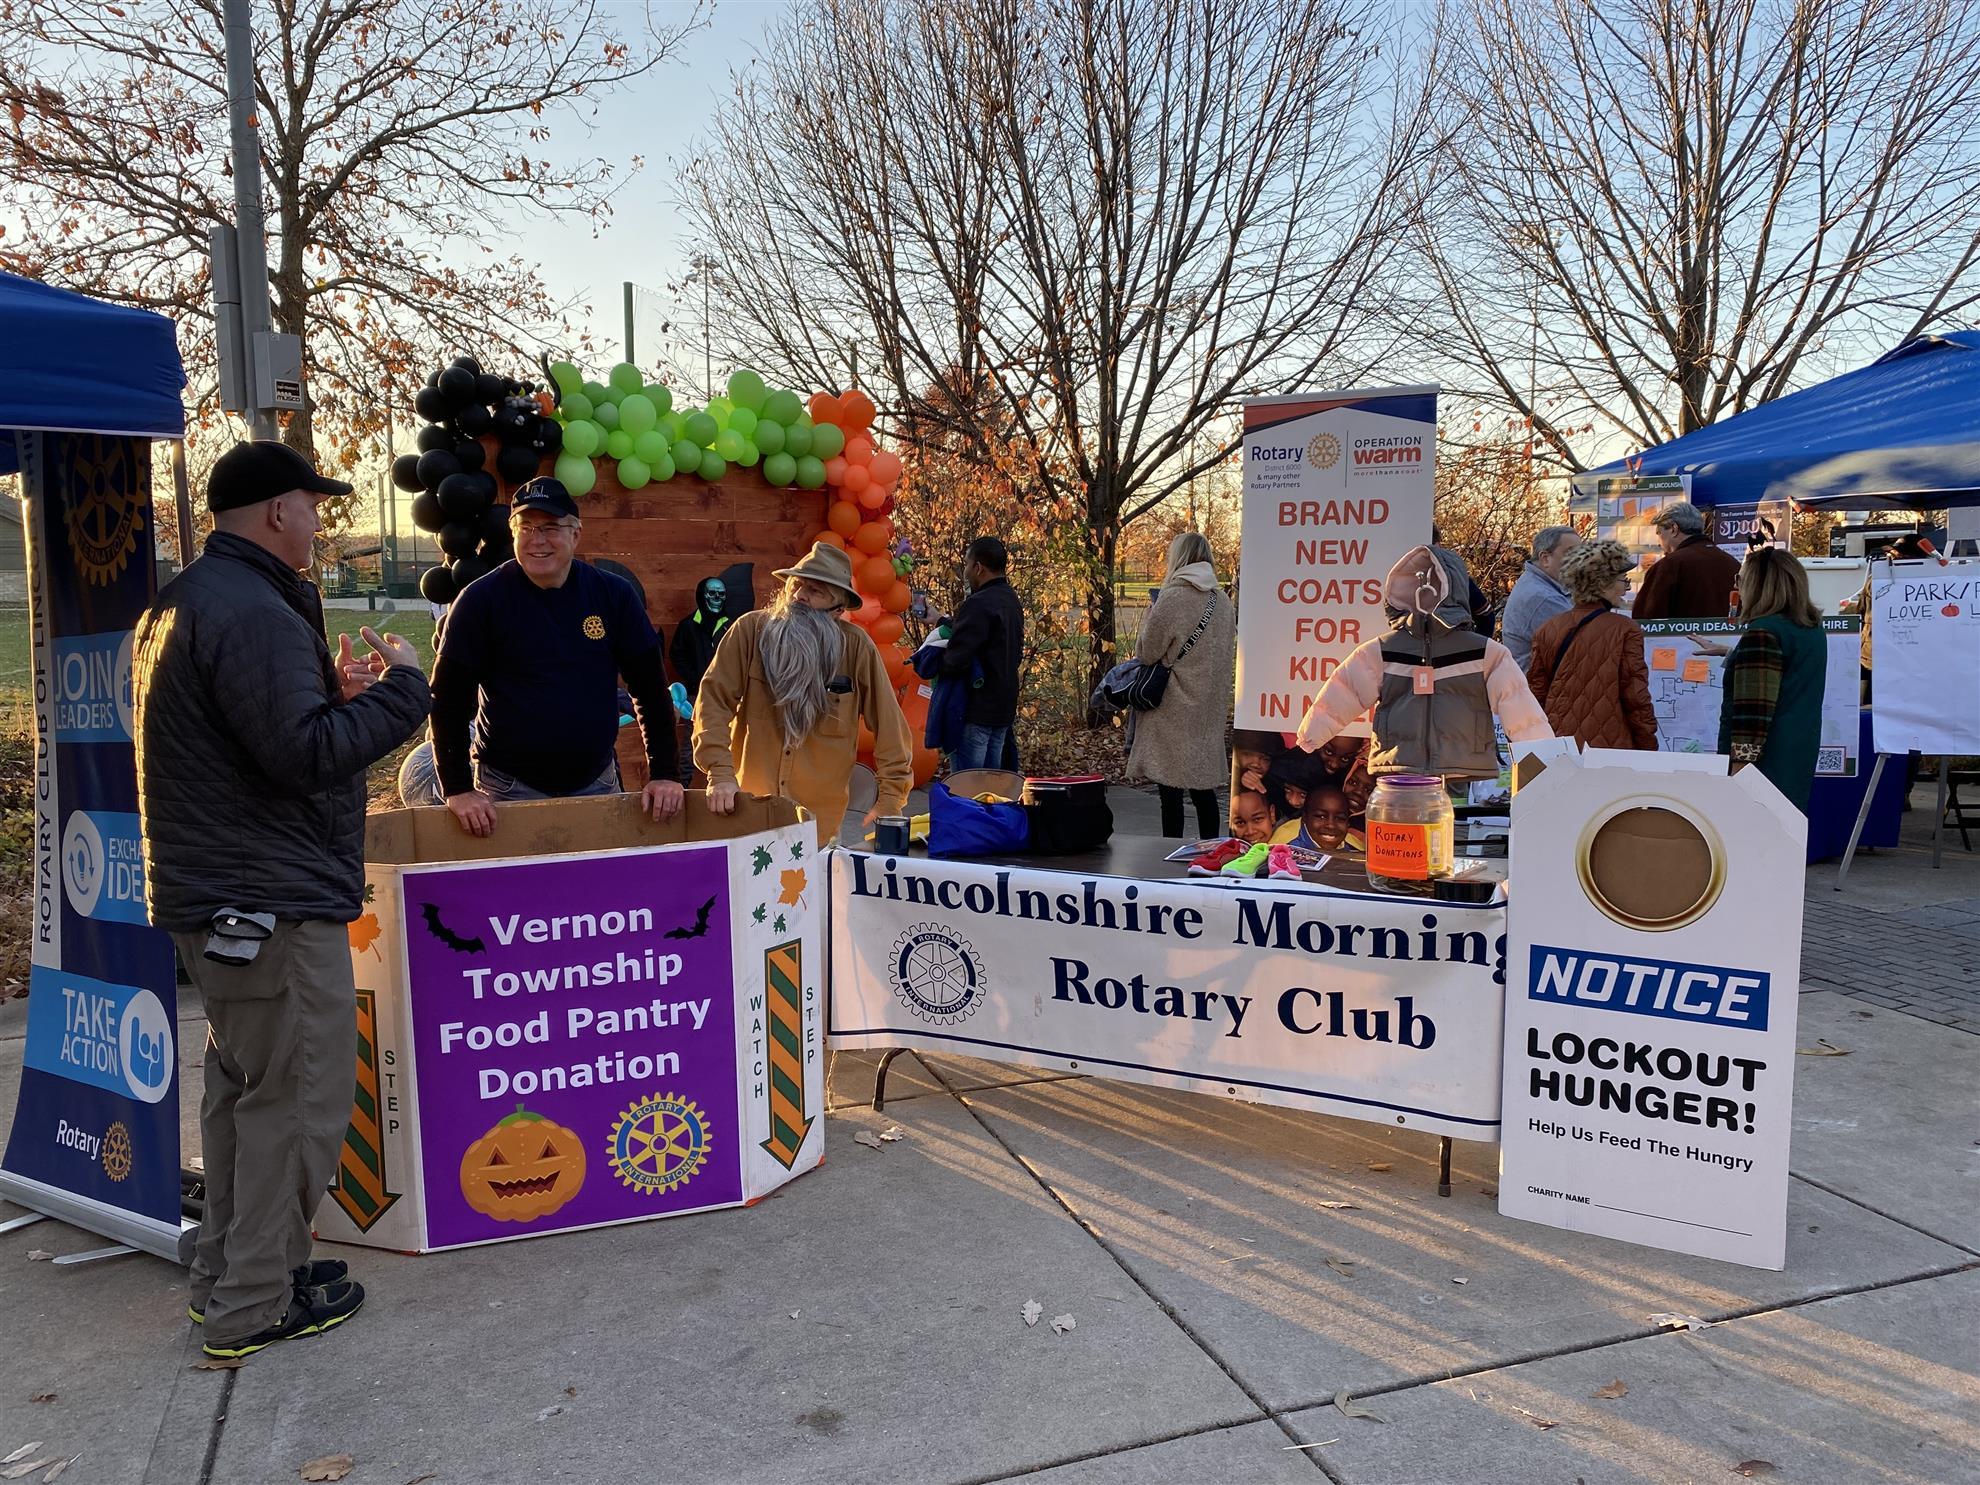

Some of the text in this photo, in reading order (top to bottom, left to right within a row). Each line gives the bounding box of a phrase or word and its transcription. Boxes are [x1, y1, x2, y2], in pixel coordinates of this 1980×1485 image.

[1251, 445, 1303, 463] Rotary
[1354, 436, 1421, 448] OPERATION
[1354, 447, 1421, 465] warm
[1250, 481, 1300, 490] Rotary Partners
[1263, 474, 1282, 482] many
[1282, 472, 1300, 480] other
[1278, 499, 1390, 526] BRAND
[1720, 516, 1782, 539] spooy
[1295, 539, 1369, 566] NEW
[1277, 578, 1382, 605] COATS
[1641, 623, 1665, 633] MAP
[1668, 622, 1700, 632] YOUR
[1703, 622, 1736, 632] IDEAS
[1889, 604, 1933, 619] LOVE
[1296, 618, 1360, 644] FOR
[35, 660, 47, 704] OF
[55, 650, 113, 702] JOIN
[1289, 656, 1339, 682] KID
[56, 702, 114, 730] LEADERS
[1260, 693, 1290, 718] IN
[38, 713, 50, 801] CLUB
[1375, 826, 1414, 843] ROTARY
[1375, 844, 1423, 858] DONATIONS
[40, 812, 51, 943] ROTARY
[107, 862, 145, 902] IDE
[849, 853, 1203, 939] Lincolnshire
[488, 906, 653, 945] Vernon
[918, 934, 953, 946] ROTARY
[462, 948, 683, 999] Township
[1535, 953, 1761, 1021] NOTICE
[61, 987, 117, 1046] TAKE
[905, 986, 970, 1014] INTERNATIONAL
[1049, 956, 1436, 1050] Rotary Club
[440, 997, 712, 1054] Food Pantry
[806, 986, 816, 1064] STEP
[60, 1034, 119, 1077] ACTION
[750, 994, 763, 1100] WATCH
[1527, 1027, 1767, 1092] LOCKOUT
[478, 1049, 681, 1100] Donation
[384, 1049, 401, 1135] STEP
[1529, 1067, 1756, 1135] HUNGER!
[636, 1102, 681, 1118] ROTARY
[56, 1119, 101, 1161] Rotary
[1528, 1117, 1754, 1173] Help Us Feed The Hungry
[625, 1152, 698, 1185] INTERNATIONAL
[1527, 1185, 1591, 1205] CHARITY NAME
